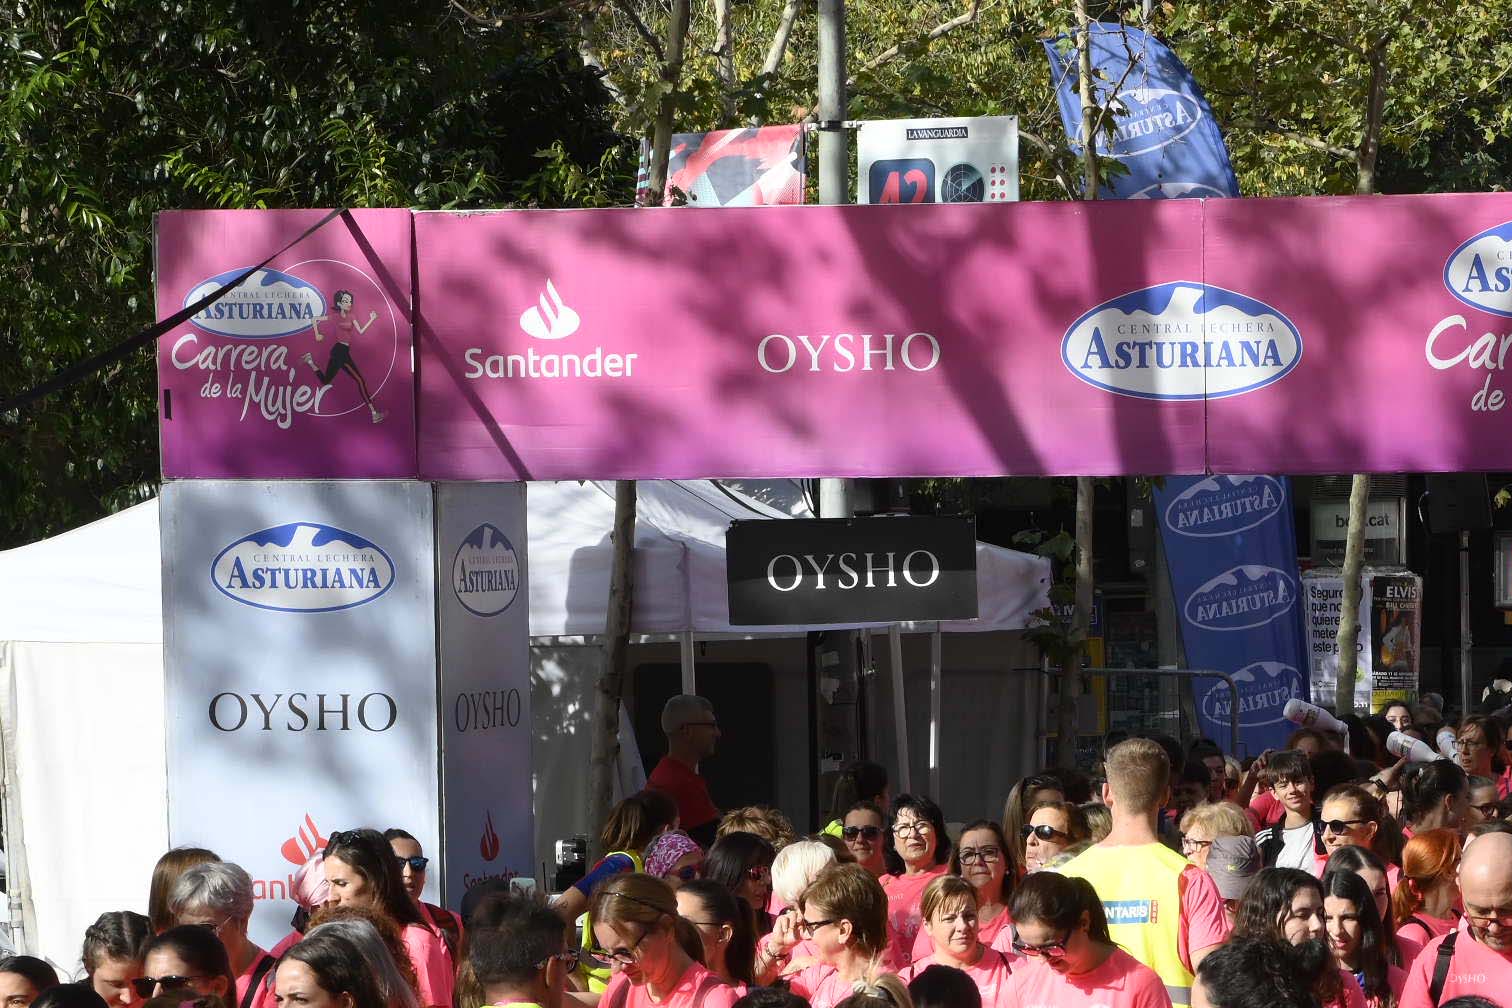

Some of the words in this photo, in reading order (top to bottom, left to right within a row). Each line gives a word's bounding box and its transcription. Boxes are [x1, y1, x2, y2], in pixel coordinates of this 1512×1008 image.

[194, 293, 314, 320] ASTURIANA
[222, 291, 261, 300] ENTRAL
[1117, 322, 1192, 335] CENTRAL
[1201, 321, 1275, 334] LECHERA
[172, 333, 288, 371] Carrera
[465, 346, 637, 380] Santander
[757, 333, 941, 374] OYSHO
[1081, 325, 1285, 370] ASTURIANA
[200, 372, 222, 398] de
[227, 372, 242, 398] la
[240, 368, 333, 430] Mujer
[1471, 373, 1505, 412] de
[226, 556, 382, 592] ASTURIANA
[253, 553, 314, 564] CENTRAL
[317, 553, 375, 563] LECHERA
[459, 559, 516, 594] ASTURIANA
[768, 549, 940, 592] OYSHO
[1386, 585, 1417, 599] ELVIS
[208, 691, 398, 733] OYSHO
[456, 689, 521, 733] OYSHO
[1105, 905, 1149, 919] NTARIS
